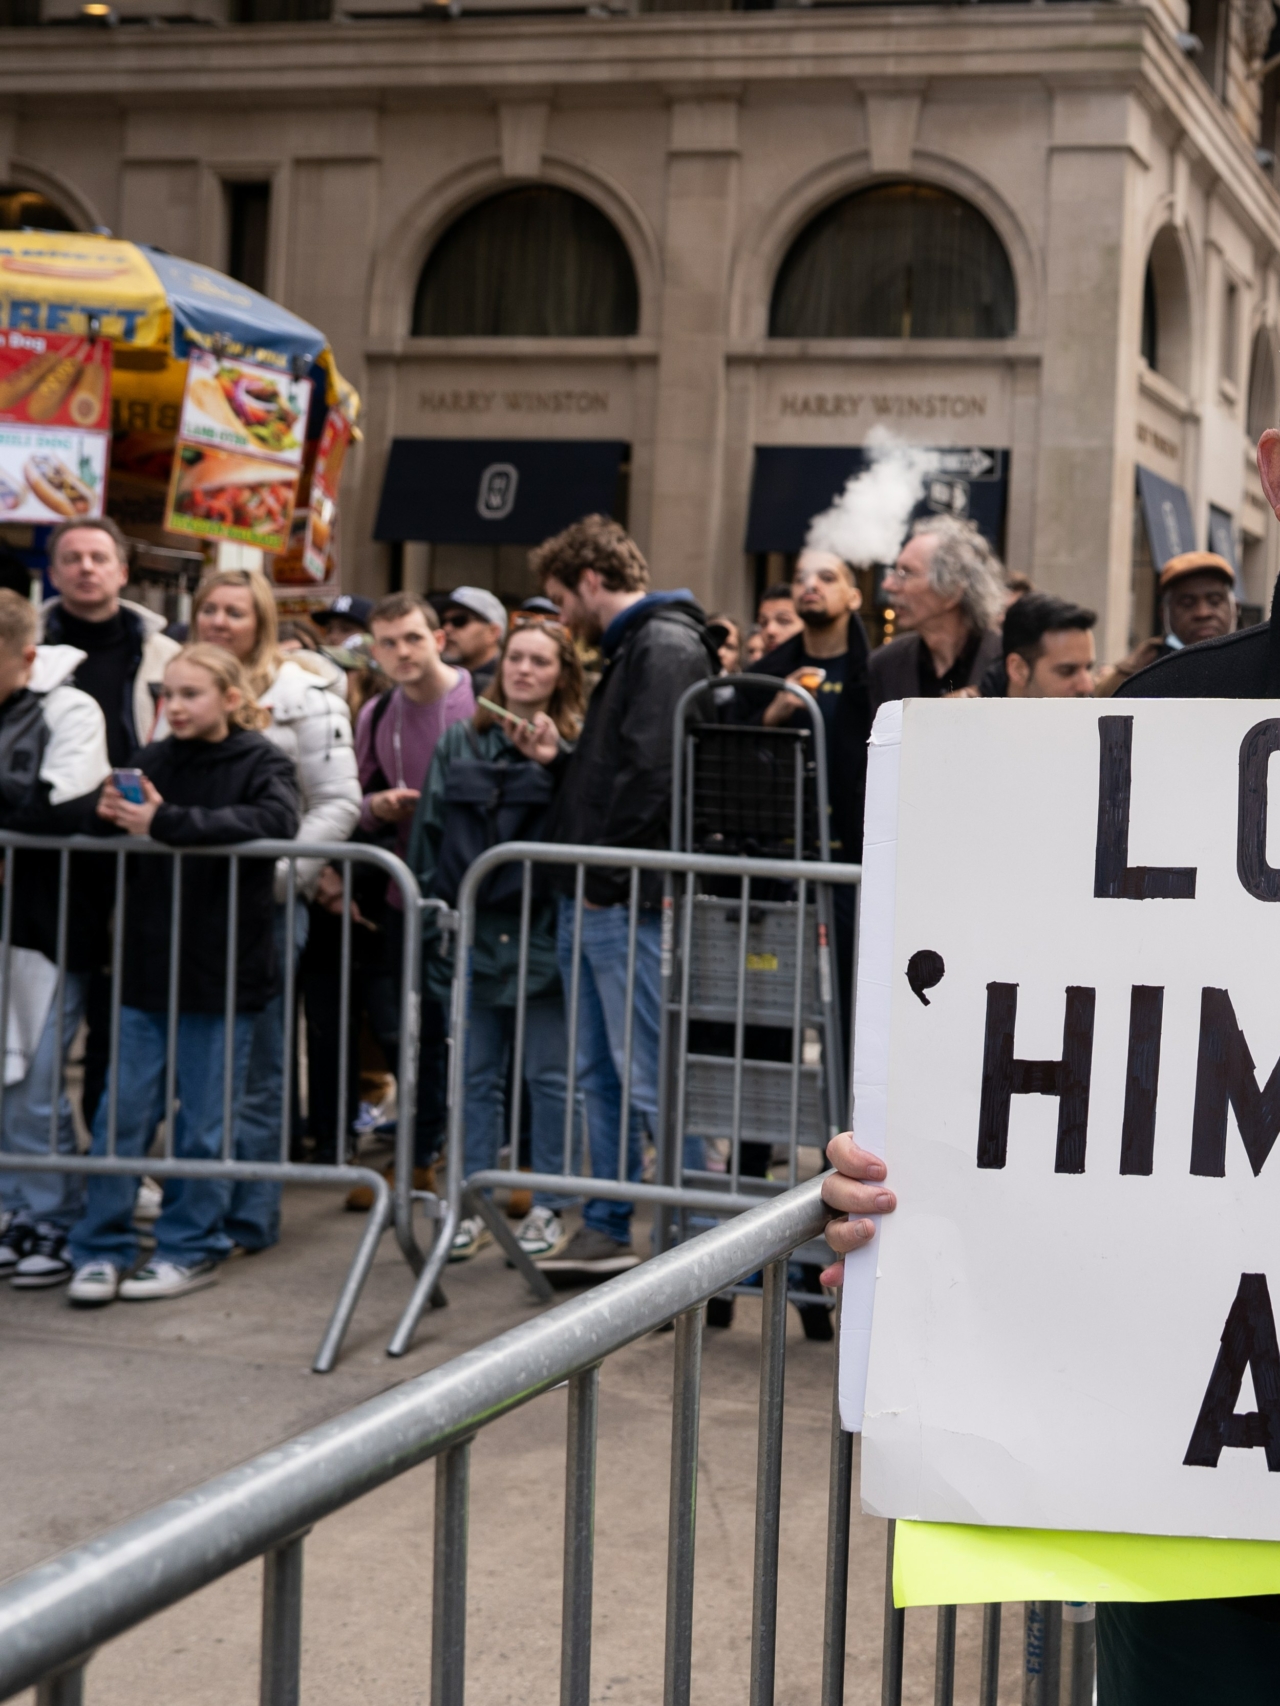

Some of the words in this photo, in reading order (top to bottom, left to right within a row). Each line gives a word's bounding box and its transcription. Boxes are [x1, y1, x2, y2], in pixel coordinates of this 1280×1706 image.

[0, 300, 147, 342] RETT
[419, 390, 496, 413] HARRY
[504, 390, 610, 414] WINSTON
[780, 393, 861, 418] HARRY
[870, 394, 987, 419] WINSTON
